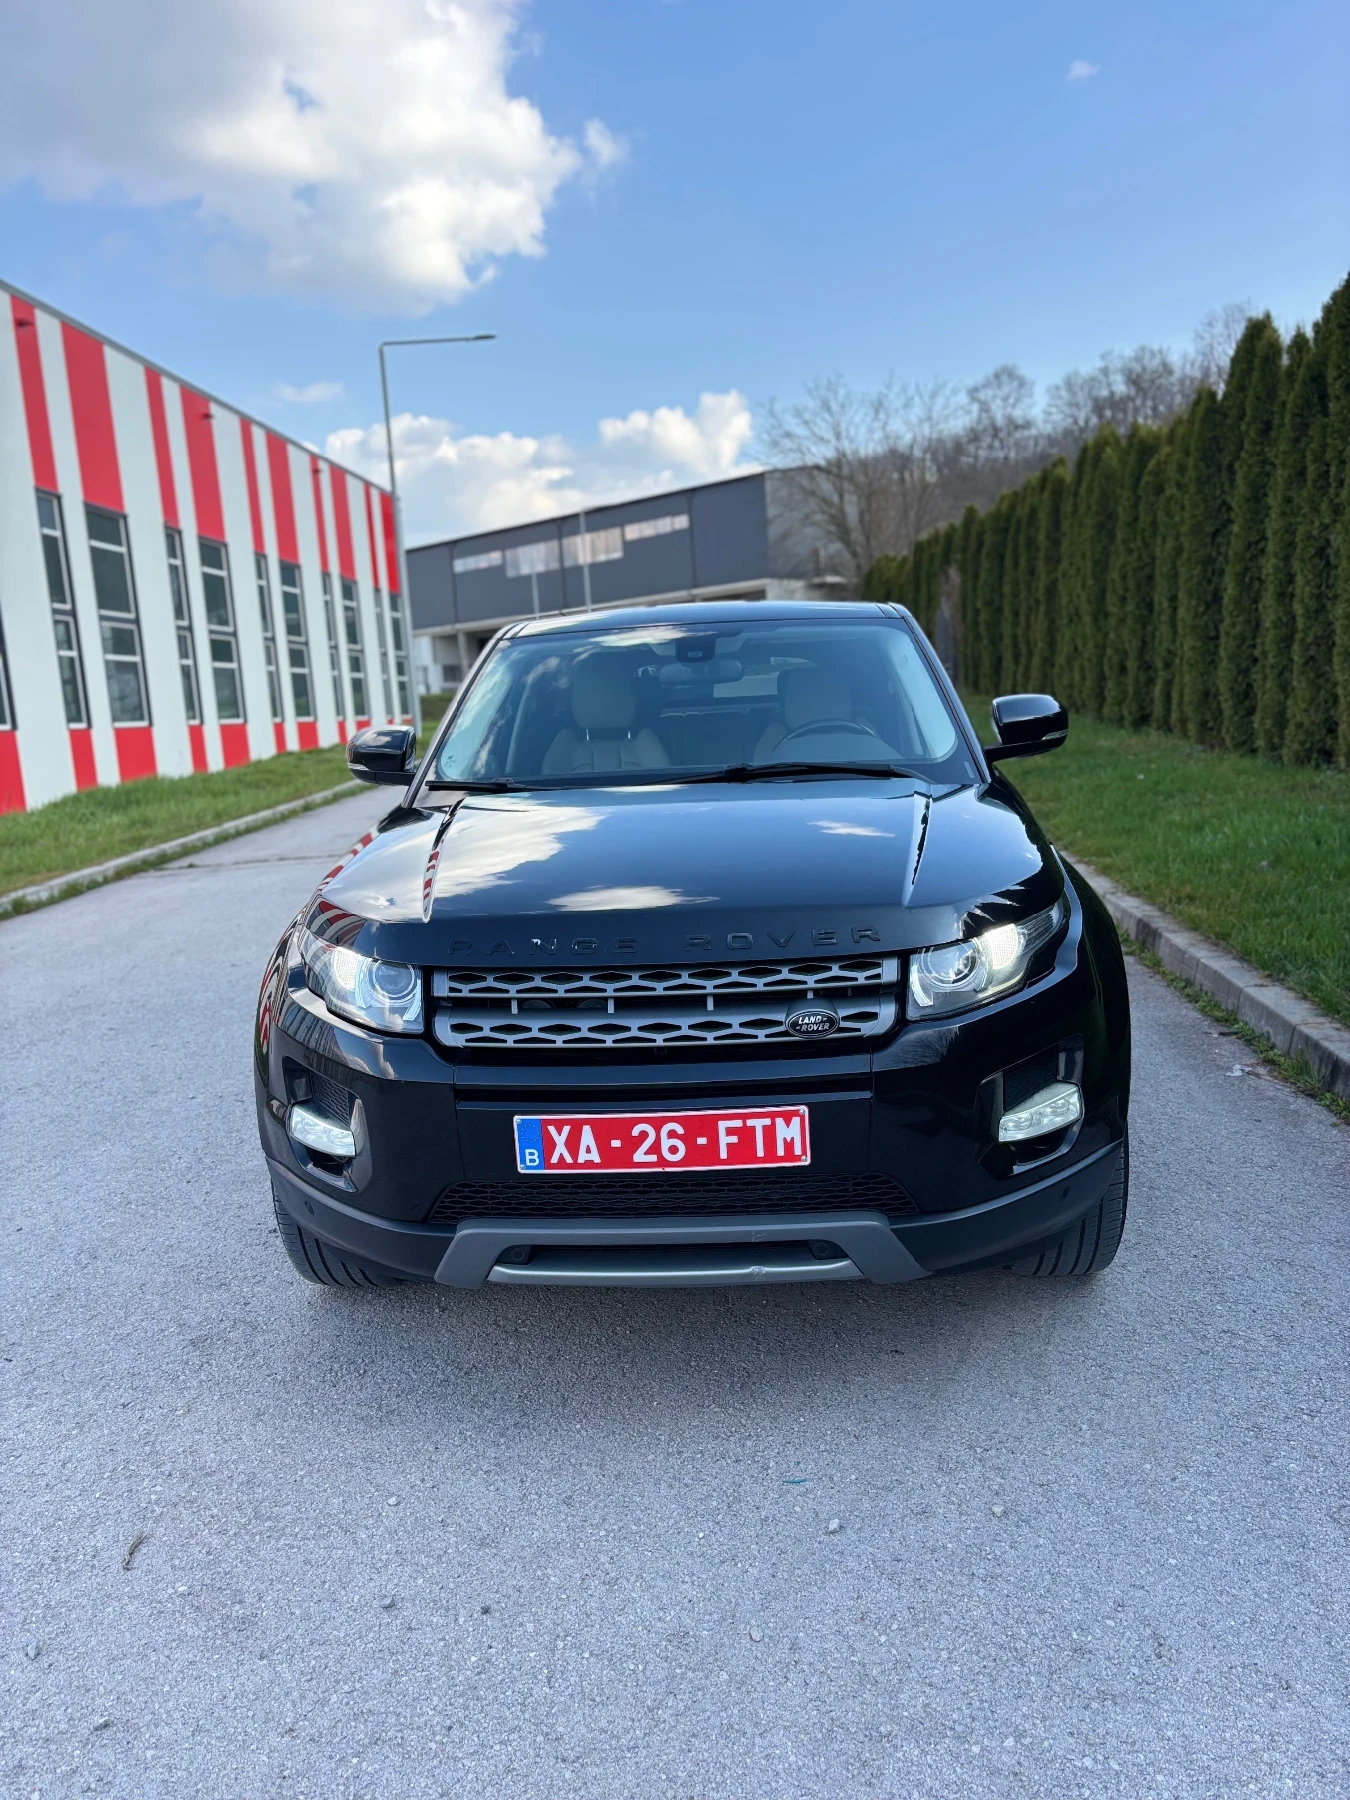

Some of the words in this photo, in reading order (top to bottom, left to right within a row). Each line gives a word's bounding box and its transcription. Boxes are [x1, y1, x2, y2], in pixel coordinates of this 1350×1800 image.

[448, 937, 637, 955] RANGE
[683, 924, 881, 952] ROVER
[799, 1016, 821, 1024] LAND
[801, 1022, 830, 1031] ROVER
[524, 1149, 540, 1166] B
